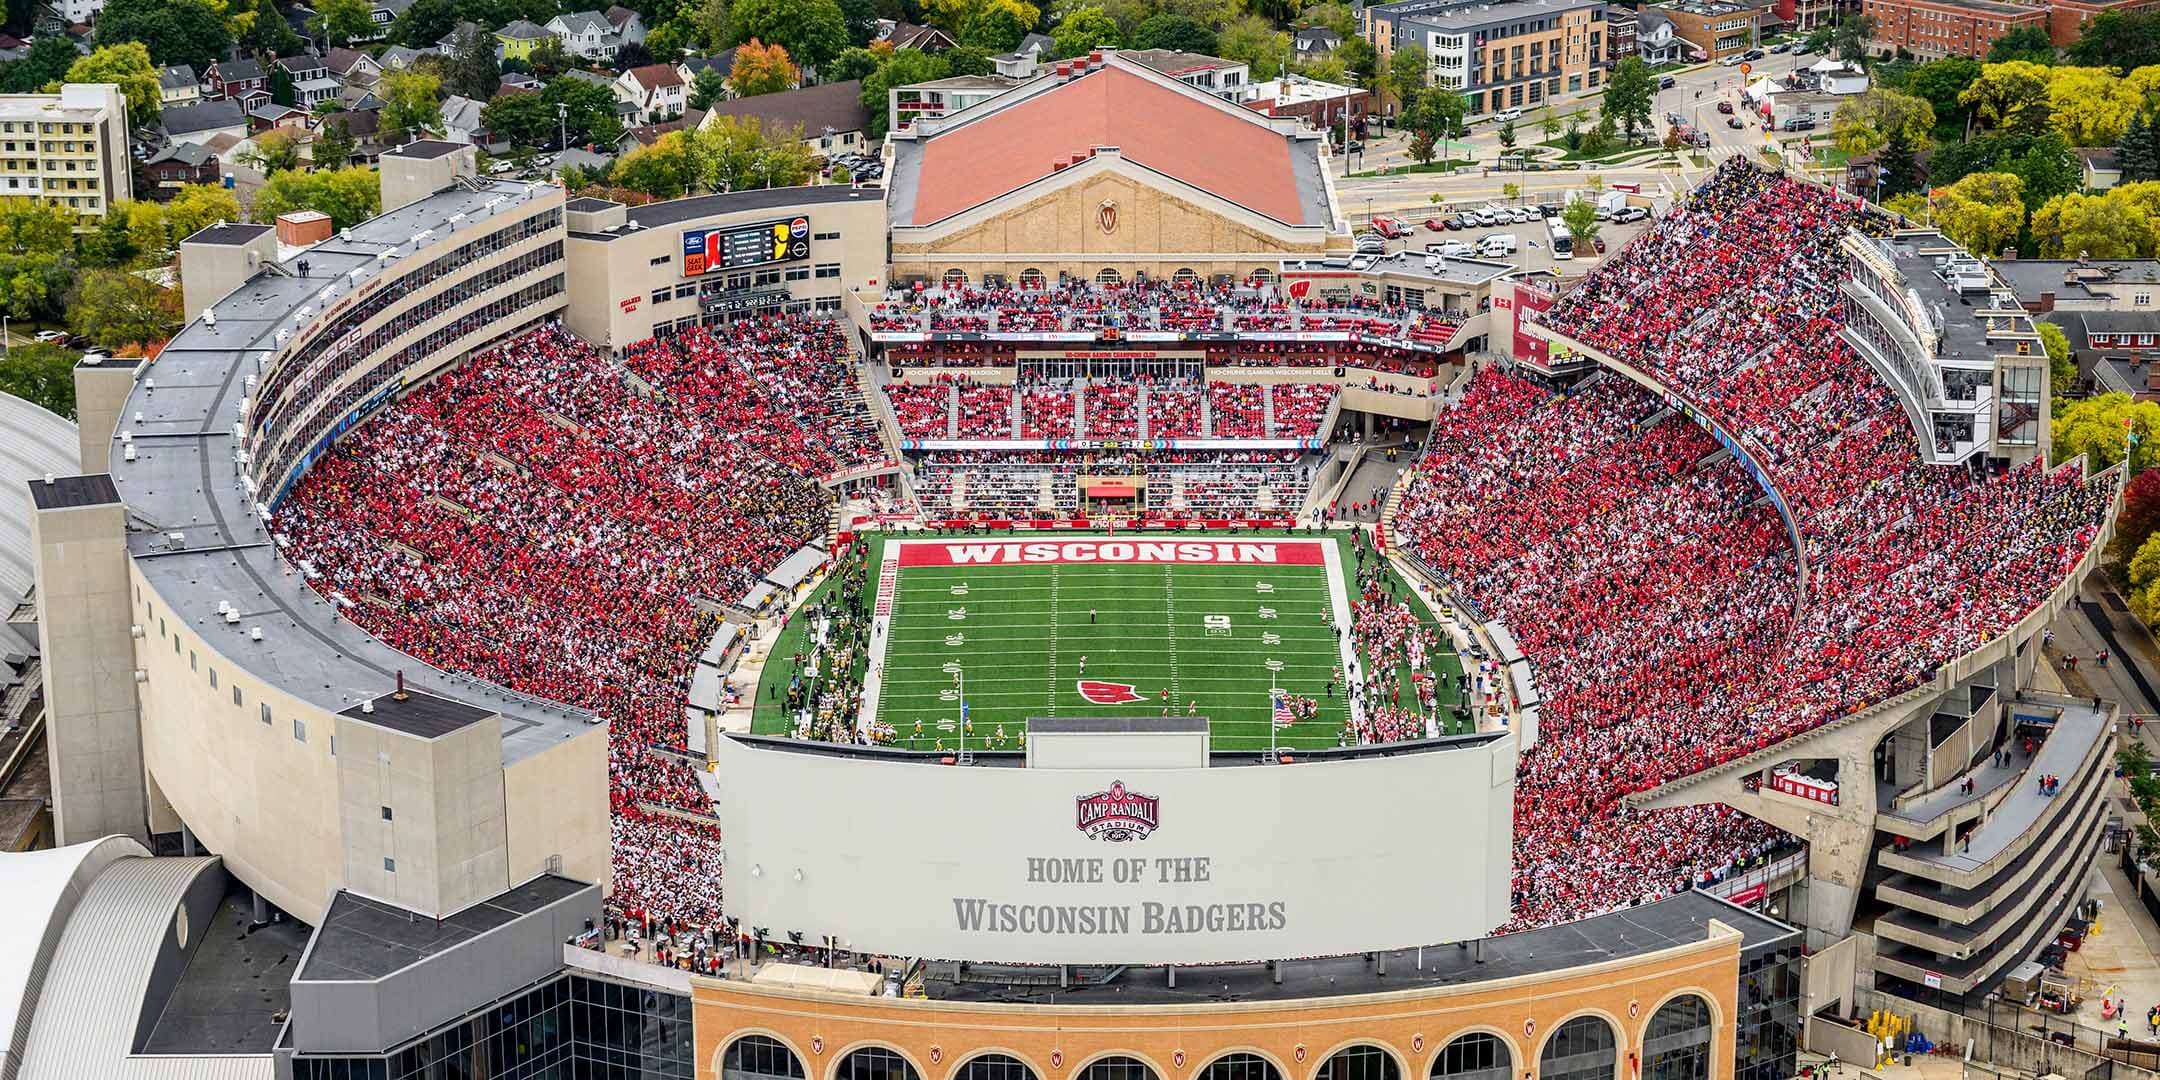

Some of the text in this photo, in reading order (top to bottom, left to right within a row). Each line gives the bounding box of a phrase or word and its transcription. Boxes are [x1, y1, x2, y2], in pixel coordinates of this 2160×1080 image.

[945, 543, 1278, 563] WISCONSIN
[1080, 802, 1155, 825] CAMP RANDALL
[1092, 822, 1144, 832] STADIUM
[1027, 857, 1211, 883] HOME OF THE
